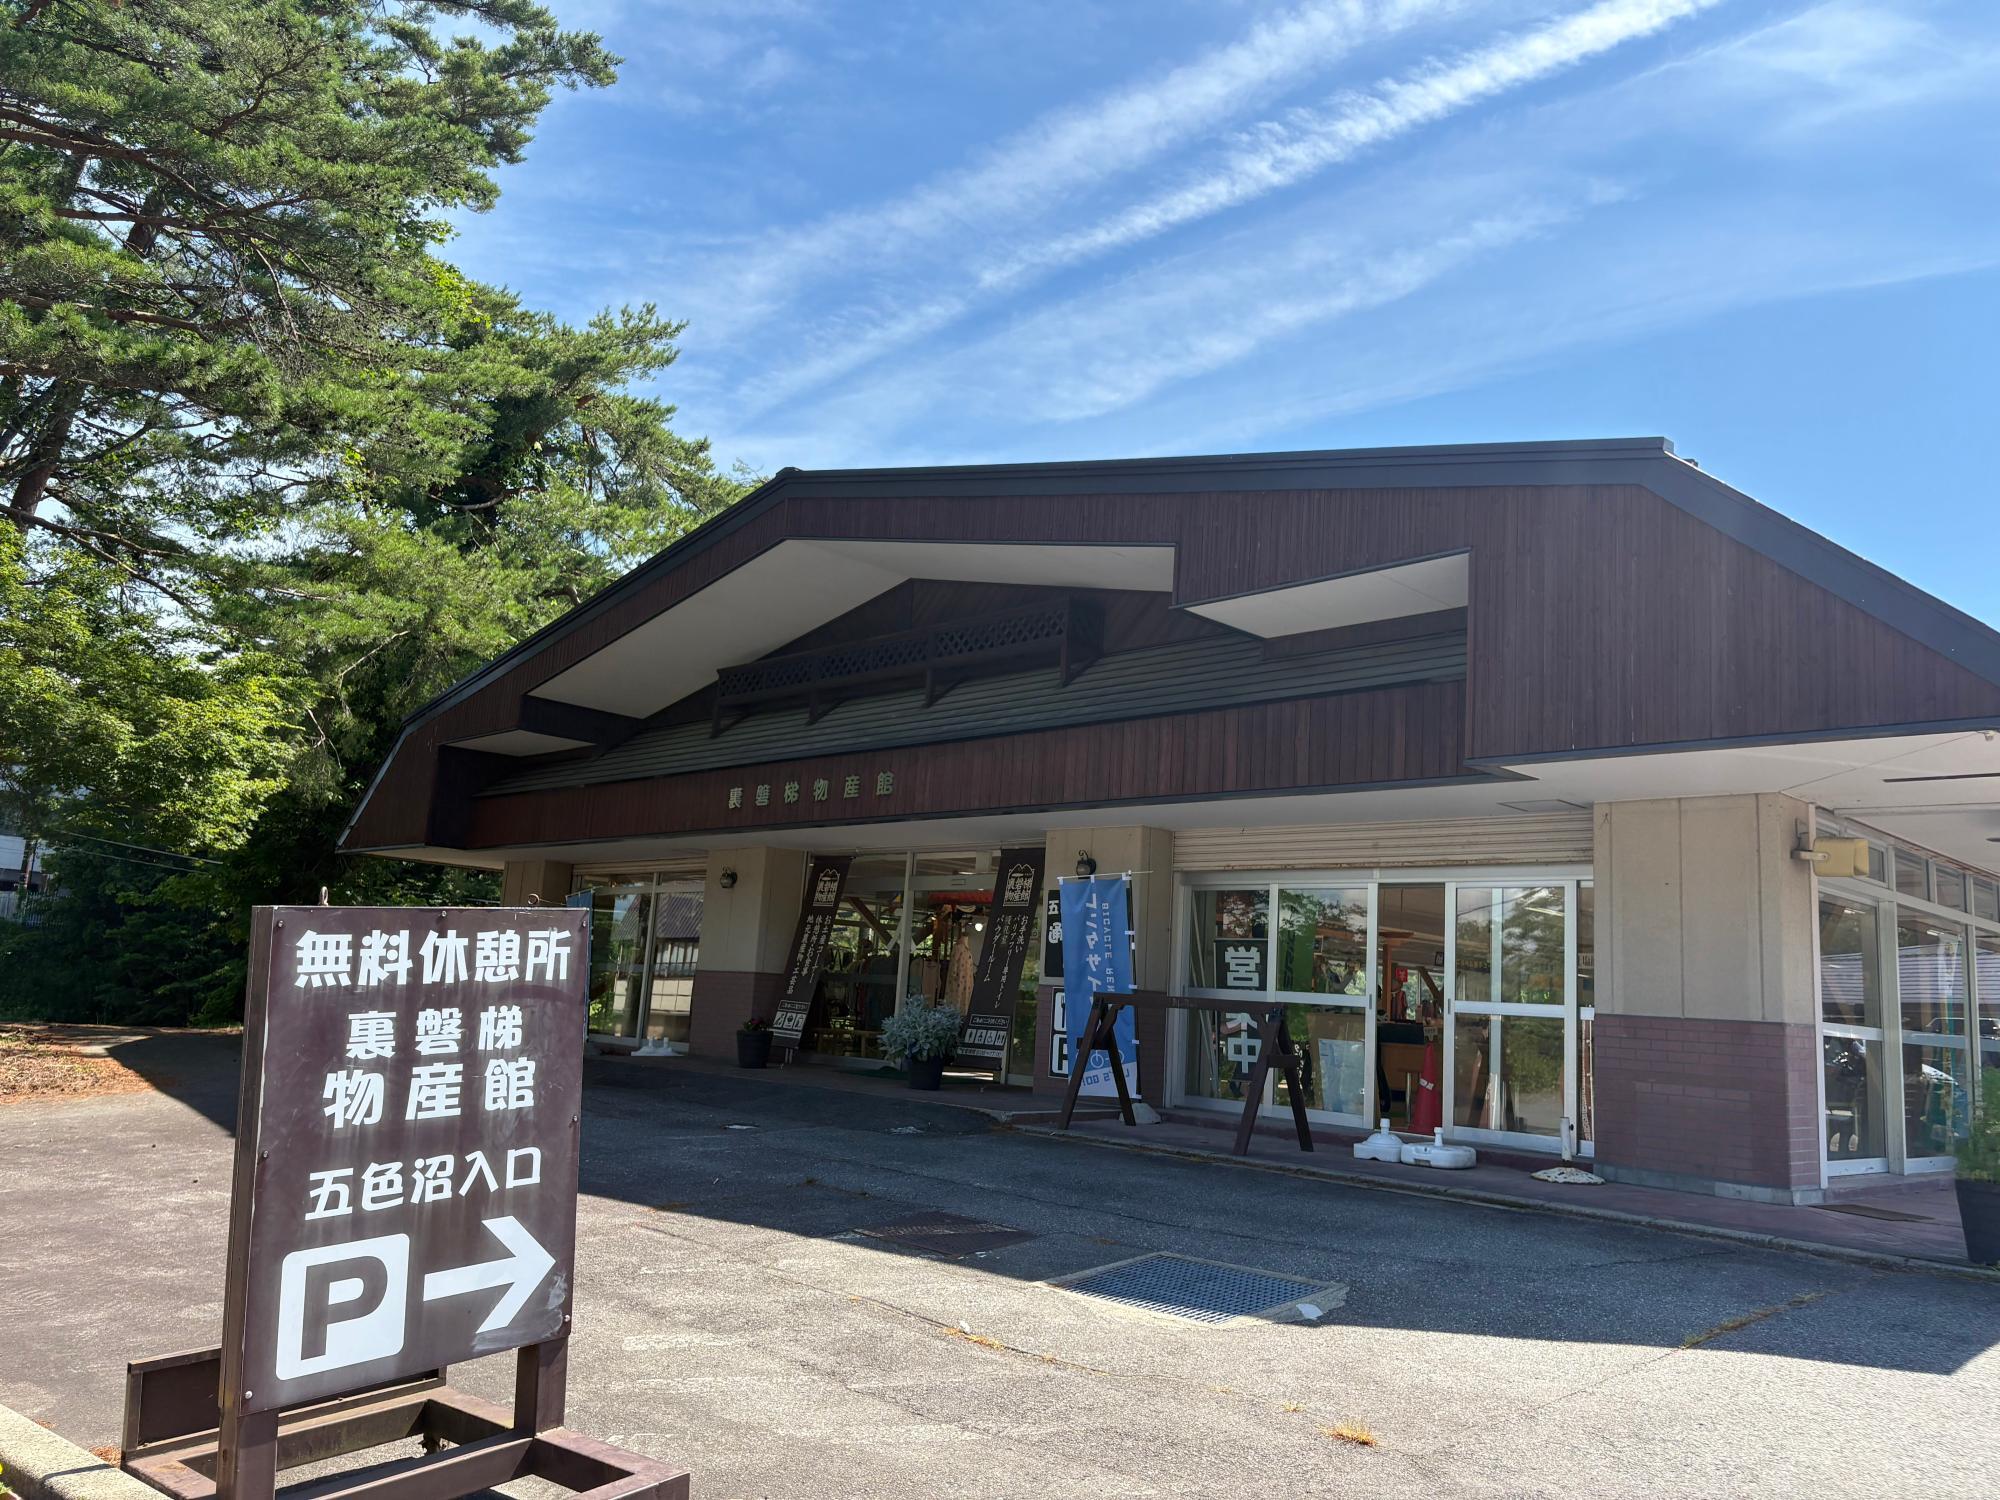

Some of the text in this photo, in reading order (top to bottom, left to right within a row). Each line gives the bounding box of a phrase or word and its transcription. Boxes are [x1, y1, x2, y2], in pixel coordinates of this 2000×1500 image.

[728, 770, 895, 809] 裏磐梯物産館
[294, 929, 572, 988] 無料休憩所
[345, 1005, 524, 1060] 裏磐梯
[322, 1056, 537, 1130] 物産館
[305, 1146, 542, 1221] 五色沼入口
